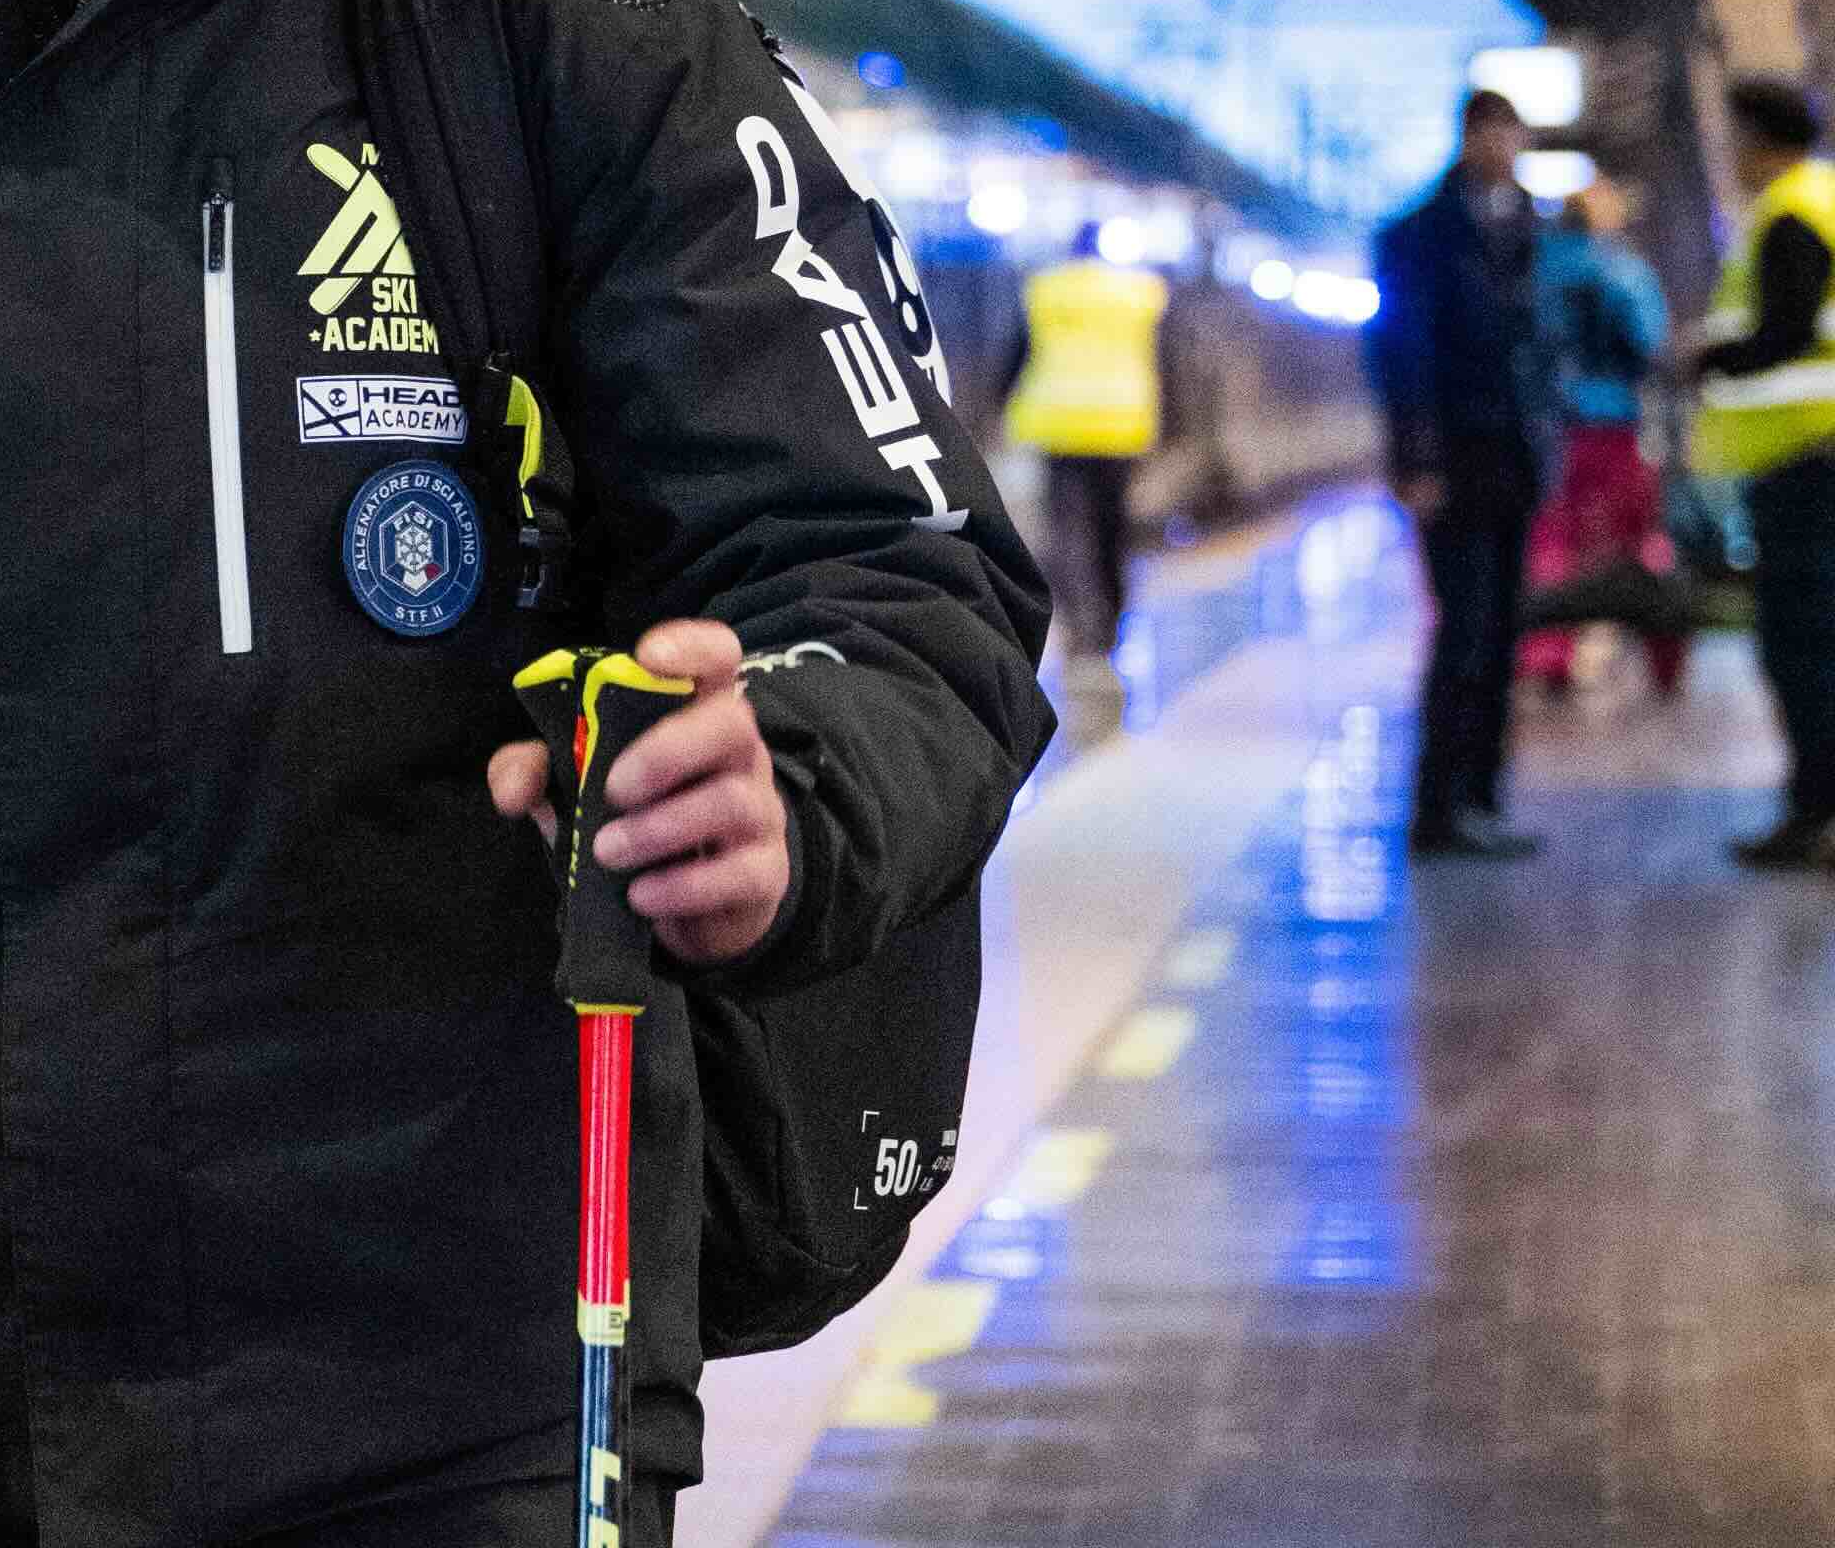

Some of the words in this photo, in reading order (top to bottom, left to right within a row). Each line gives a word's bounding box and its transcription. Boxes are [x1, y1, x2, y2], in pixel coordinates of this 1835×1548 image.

[372, 277, 418, 314] SKI
[736, 115, 970, 531] HEAD
[362, 387, 459, 407] HEAD
[366, 409, 463, 432] ACADEMY
[354, 476, 410, 571] ALLENATORE
[415, 474, 430, 488] DI
[432, 479, 455, 502] SCI
[452, 502, 476, 565] ALPINO
[393, 511, 434, 532] FISI
[395, 606, 428, 622] STF
